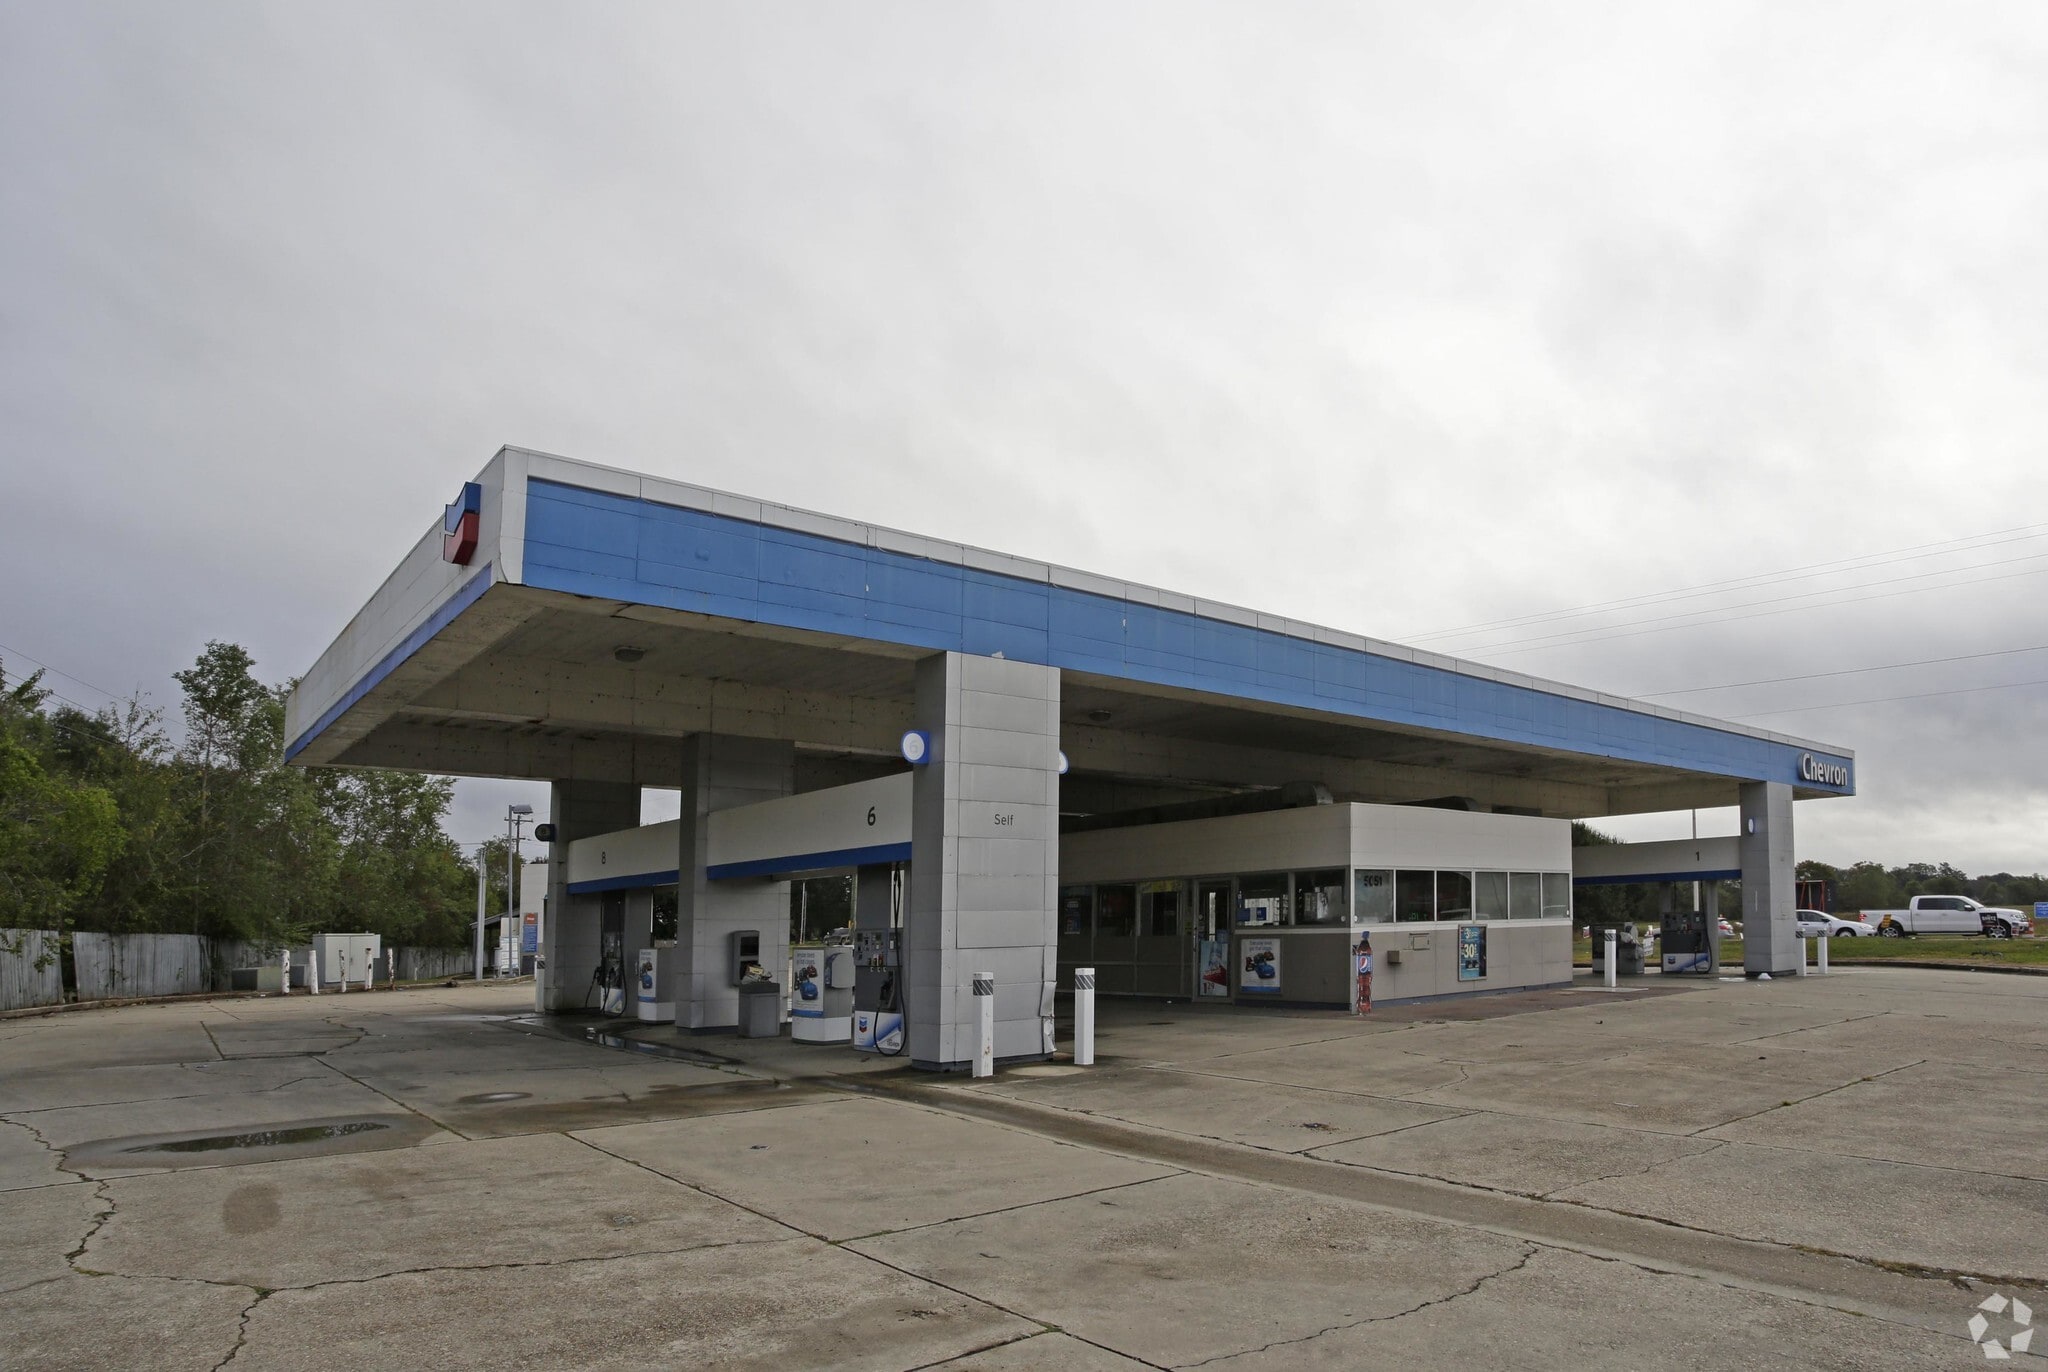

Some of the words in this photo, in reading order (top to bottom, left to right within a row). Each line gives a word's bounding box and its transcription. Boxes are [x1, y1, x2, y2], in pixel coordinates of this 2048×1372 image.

[1801, 751, 1848, 786] Chevron
[867, 806, 876, 826] 6
[994, 813, 1014, 826] Self
[601, 851, 607, 865] 8
[1695, 850, 1700, 862] 1
